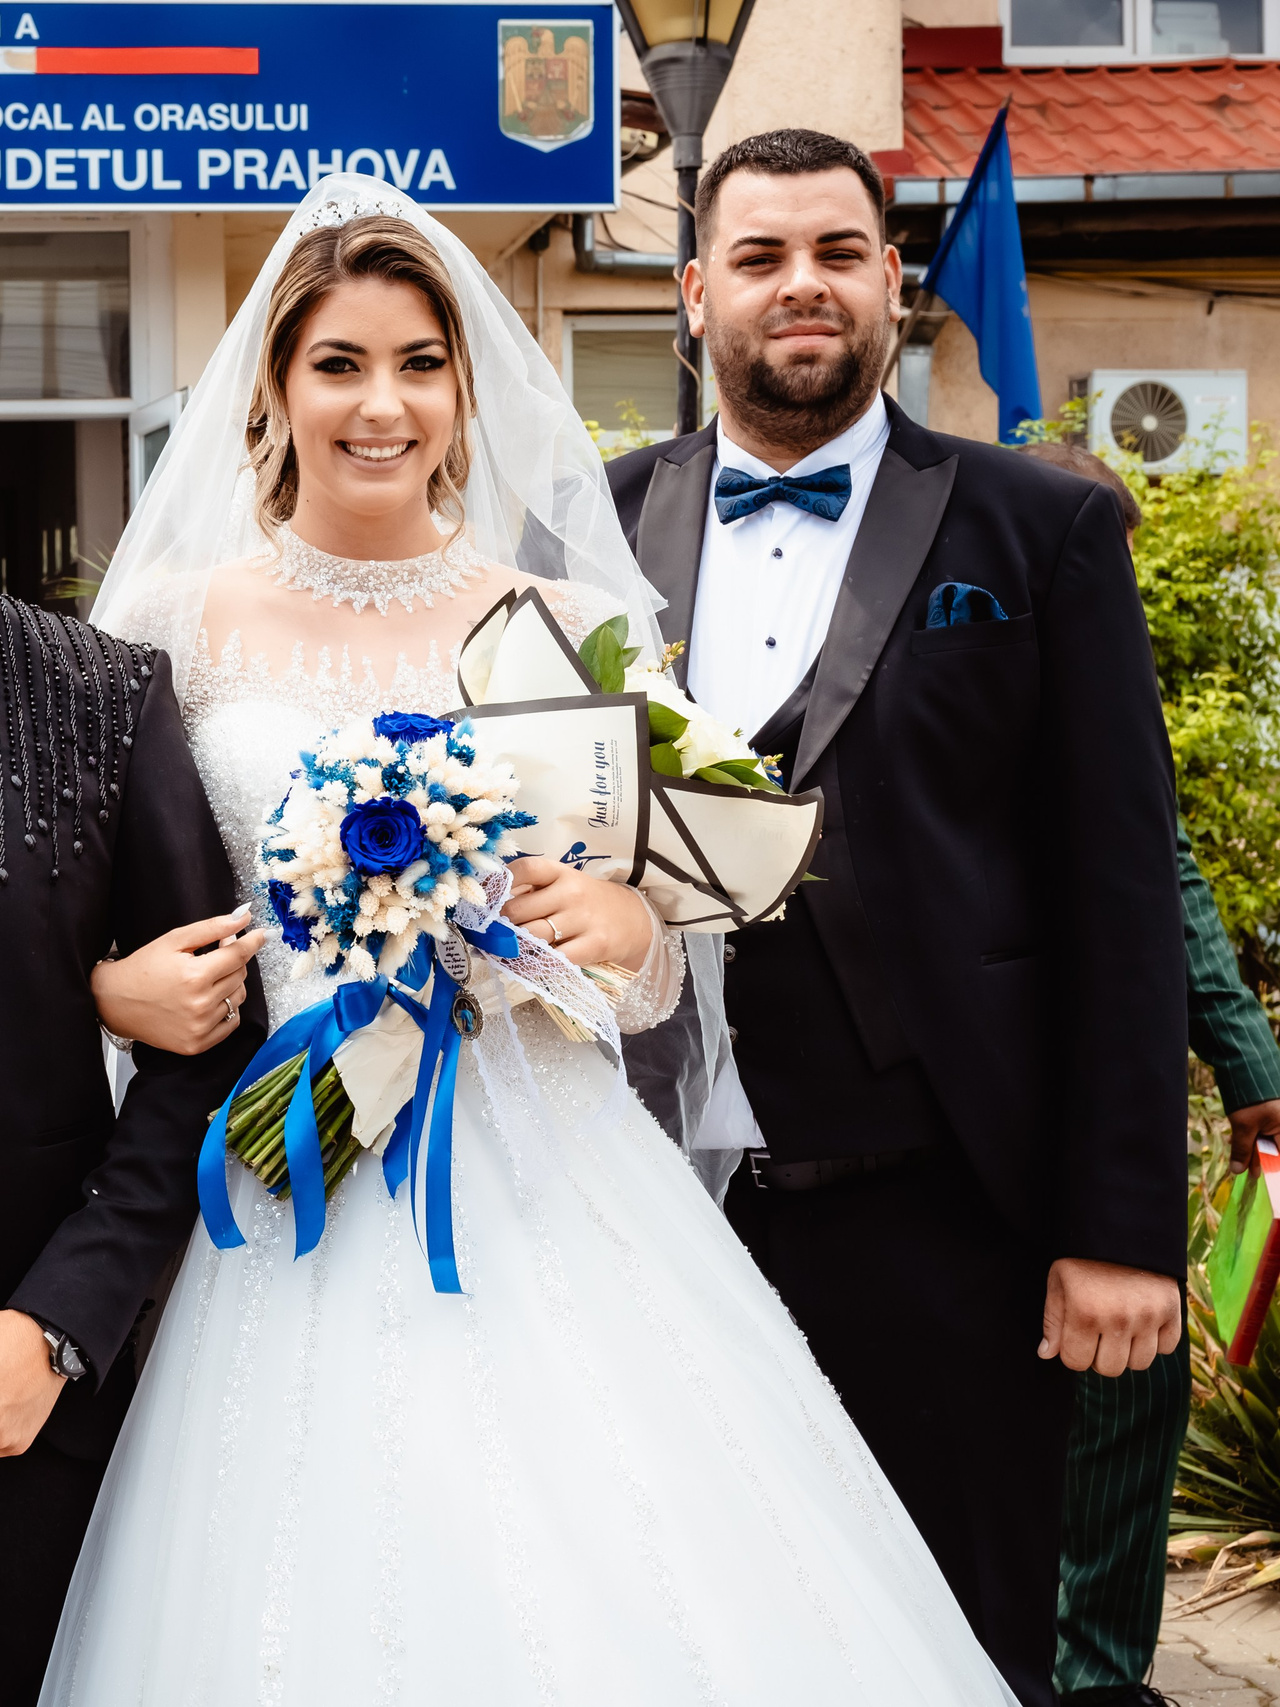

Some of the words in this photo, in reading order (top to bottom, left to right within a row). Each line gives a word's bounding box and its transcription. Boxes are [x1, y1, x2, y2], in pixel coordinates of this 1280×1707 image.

[81, 104, 125, 131] AL
[134, 103, 308, 131] ORASULUI
[198, 148, 456, 190] PRAHOVA
[593, 741, 610, 769] you
[588, 773, 611, 796] for
[587, 801, 610, 828] Just
